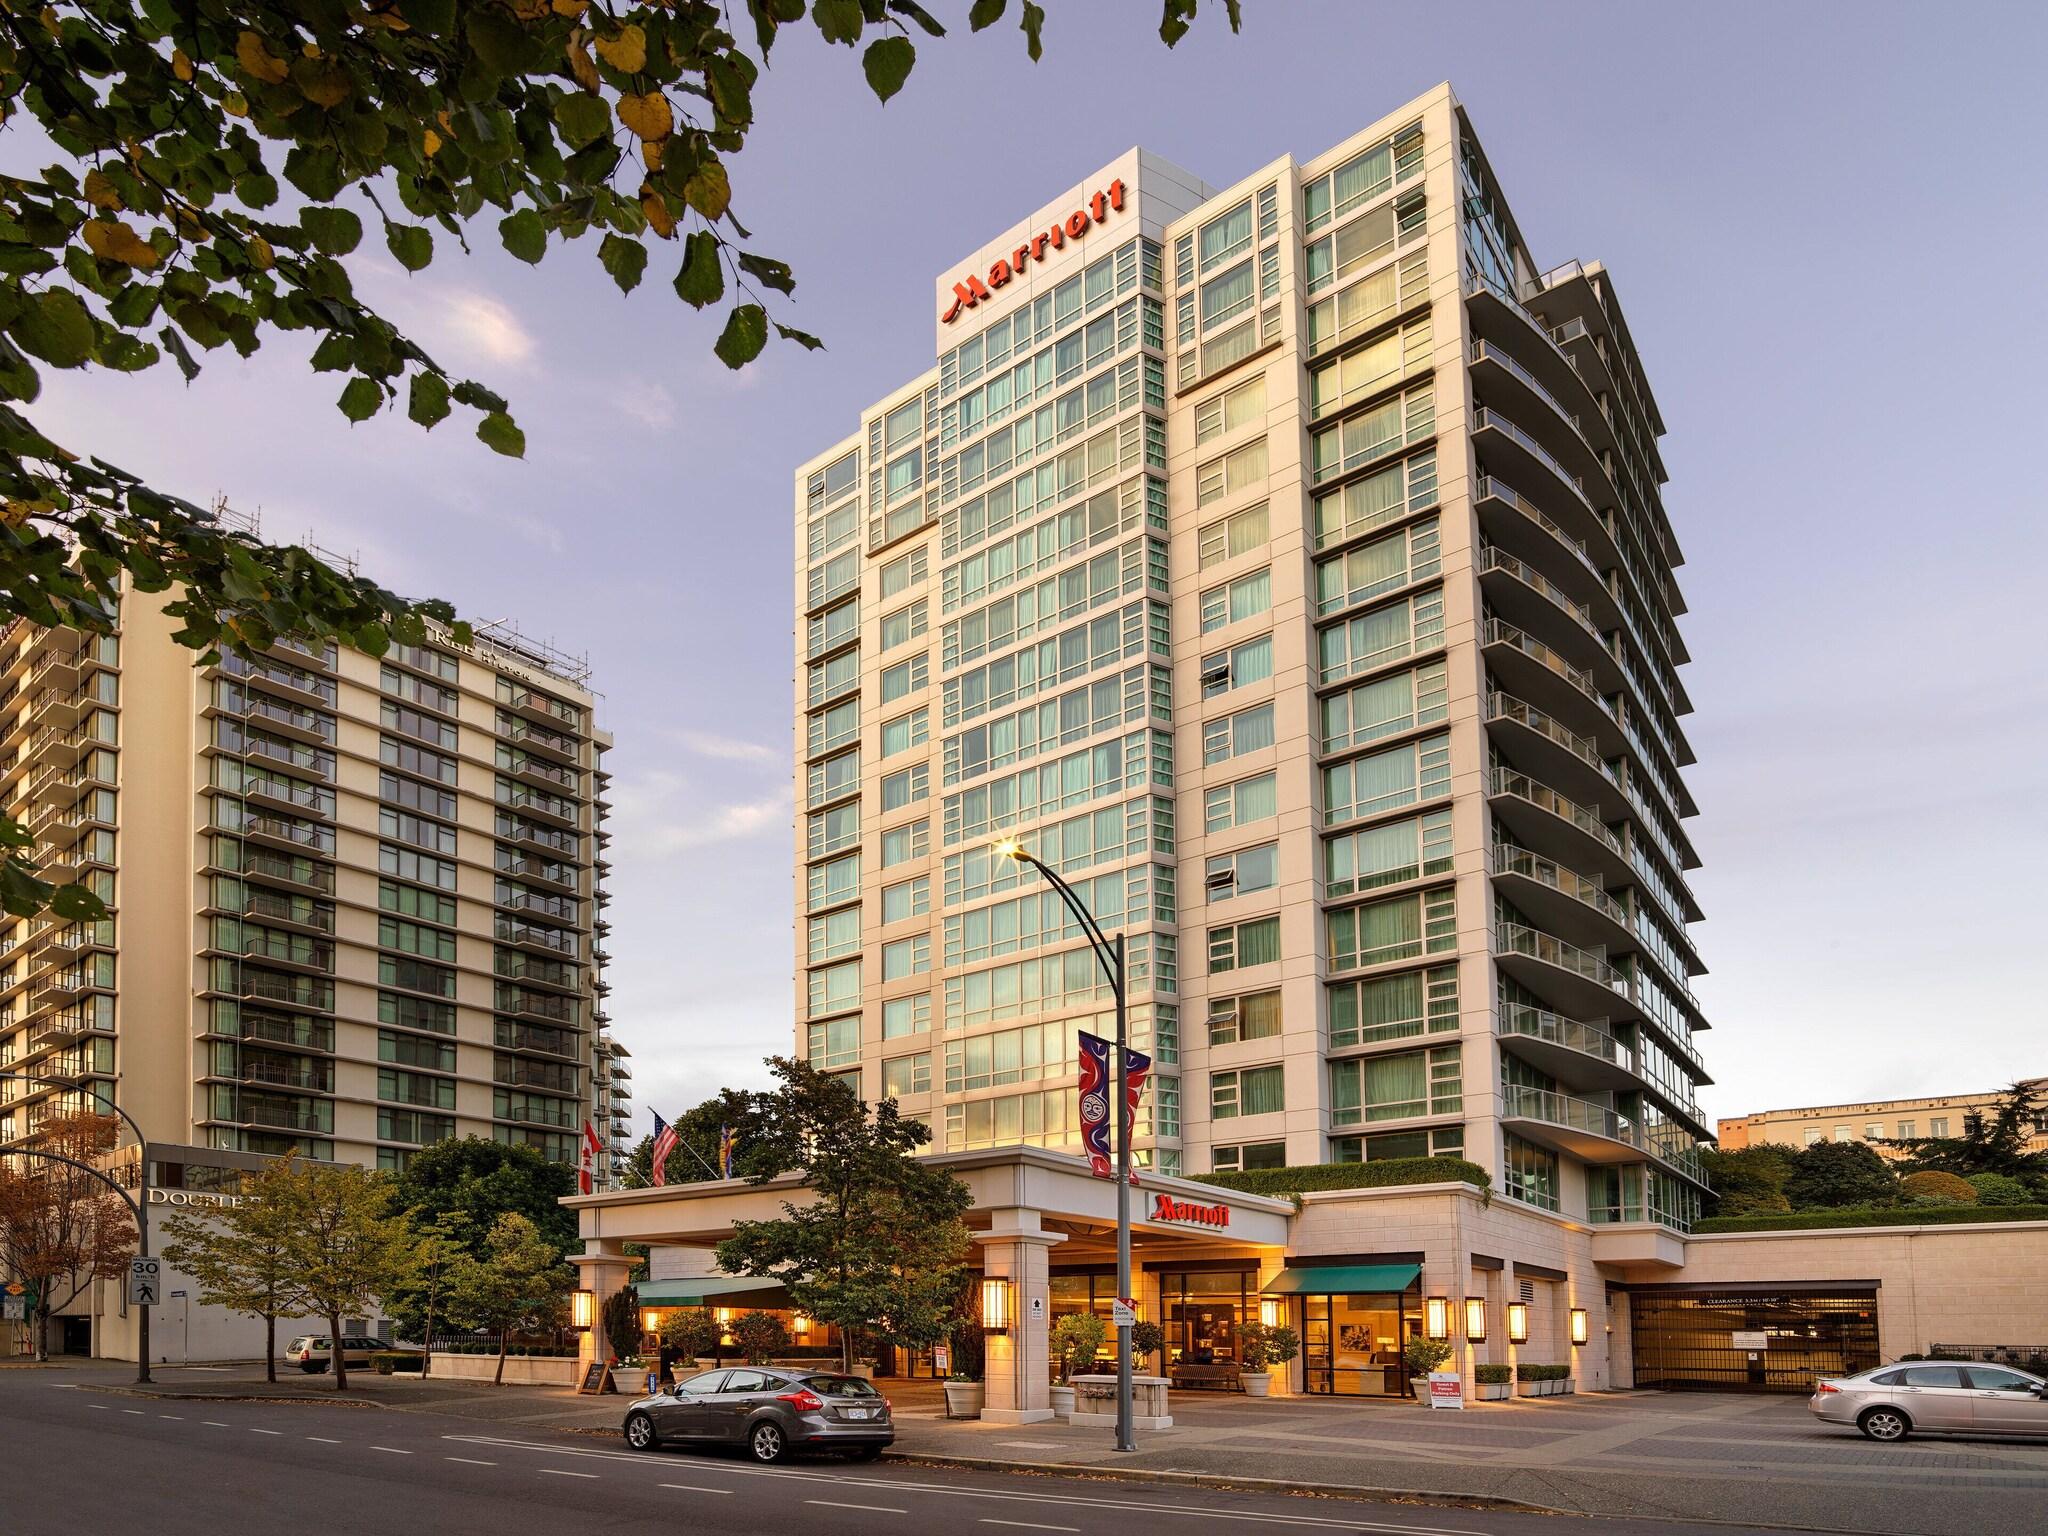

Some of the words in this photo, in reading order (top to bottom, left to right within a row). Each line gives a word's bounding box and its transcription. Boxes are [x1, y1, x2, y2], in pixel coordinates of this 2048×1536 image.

[941, 178, 1125, 324] Marriott
[481, 656, 531, 681] HILTON
[1150, 1194, 1229, 1227] Marriott
[132, 1262, 158, 1274] 30
